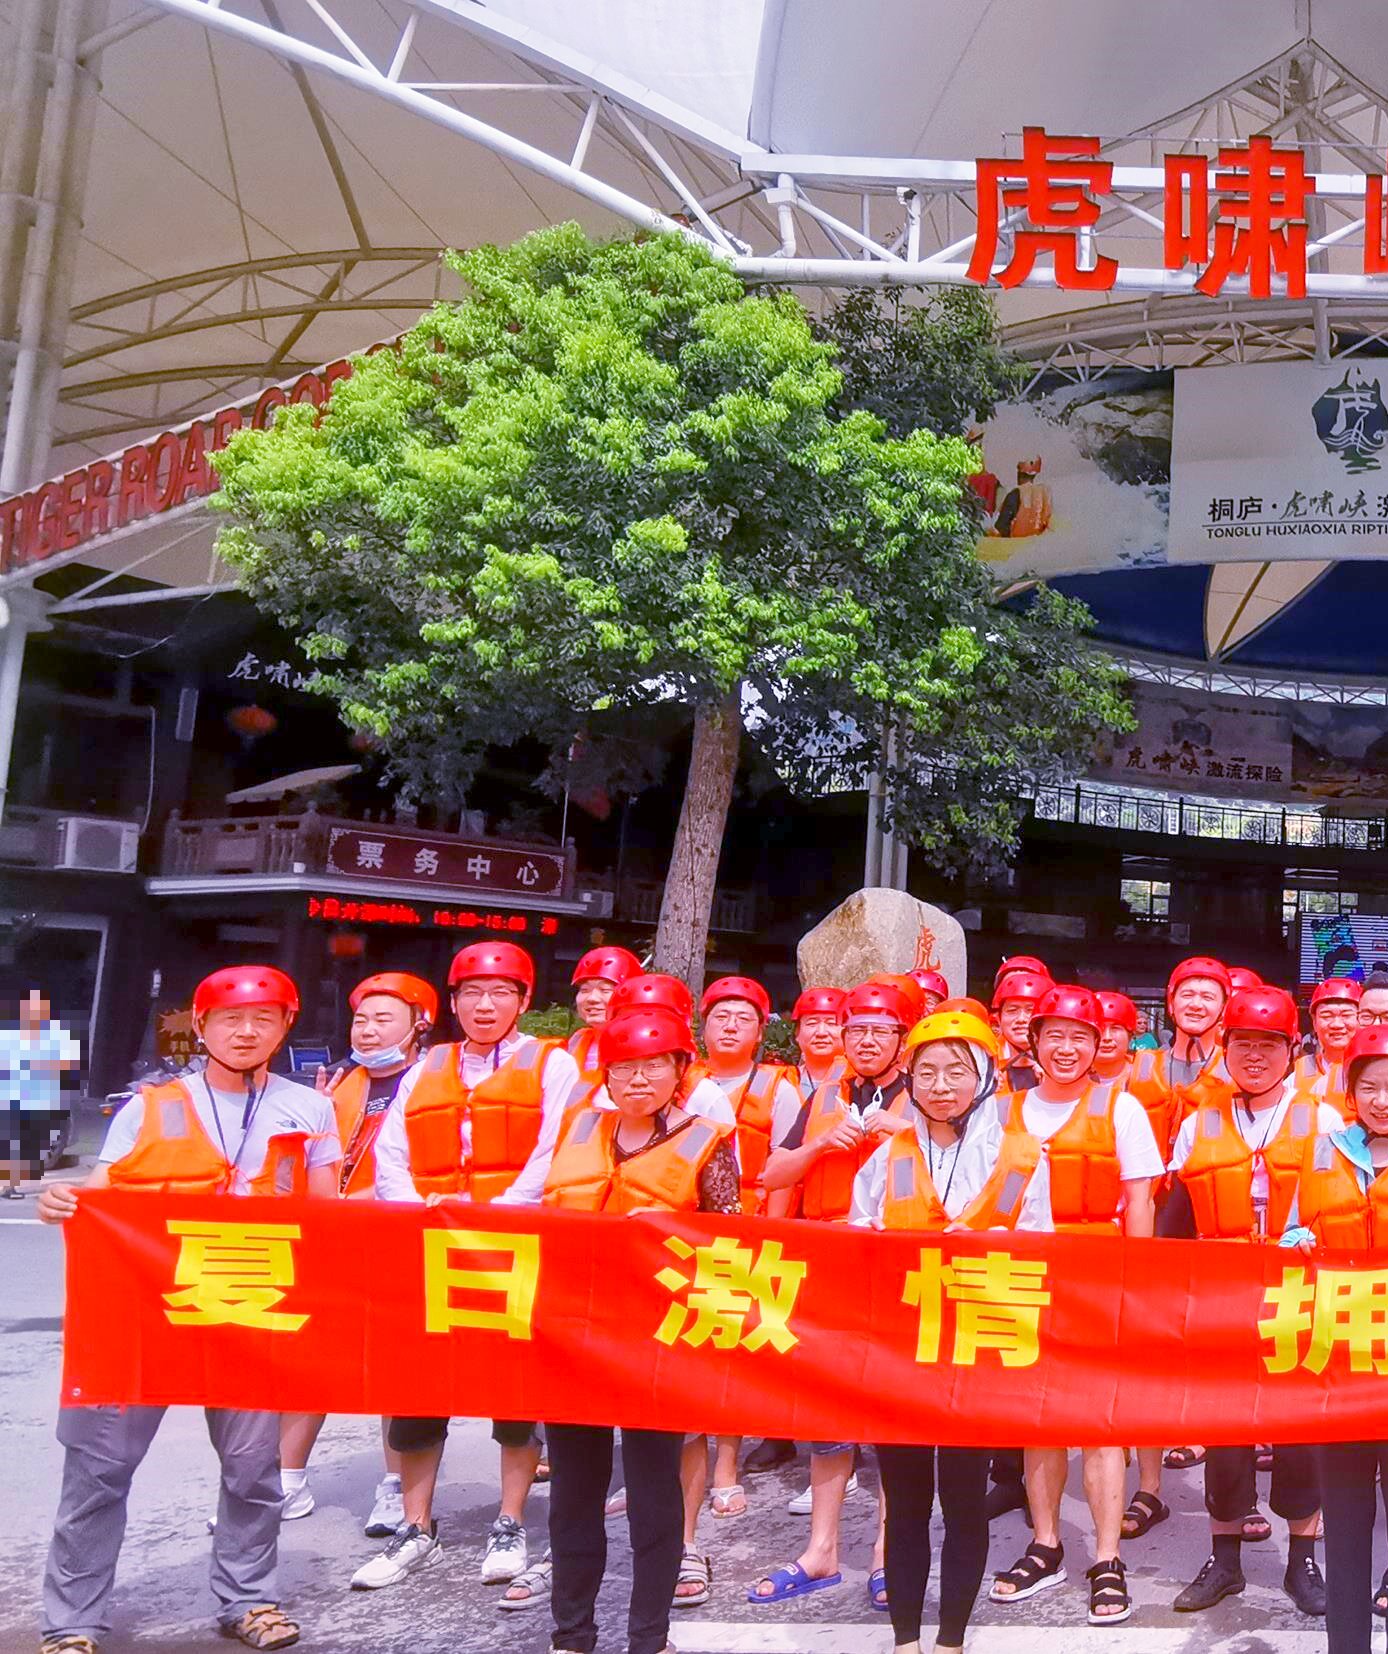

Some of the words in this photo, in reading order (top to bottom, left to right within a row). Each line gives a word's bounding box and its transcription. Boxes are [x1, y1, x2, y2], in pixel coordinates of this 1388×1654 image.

[1207, 526, 1261, 539] TONGLU
[1267, 524, 1347, 536] HUXIAOXIA
[357, 840, 539, 886] 票务中心
